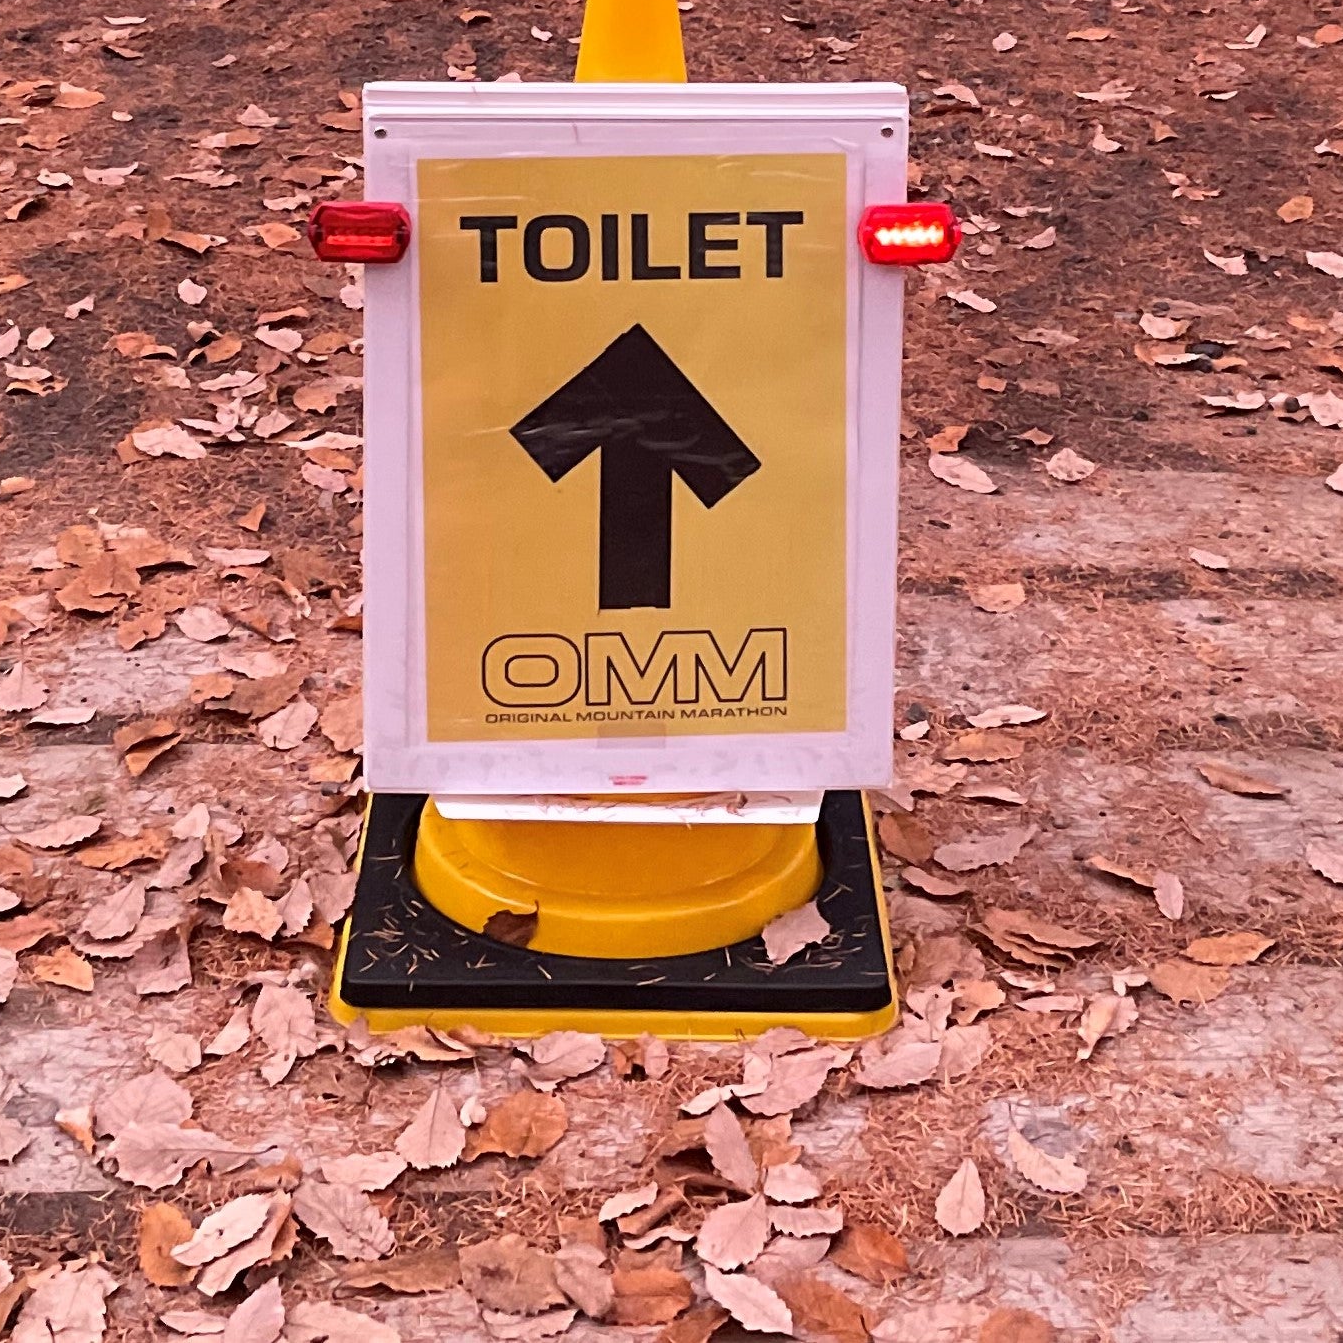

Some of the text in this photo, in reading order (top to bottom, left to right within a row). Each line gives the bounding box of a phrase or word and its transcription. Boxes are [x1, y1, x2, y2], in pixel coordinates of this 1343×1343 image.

[459, 210, 804, 283] TOILET
[481, 627, 788, 708] OMM
[484, 706, 788, 724] ORIGINAL MOUNTAIN MARATHON
